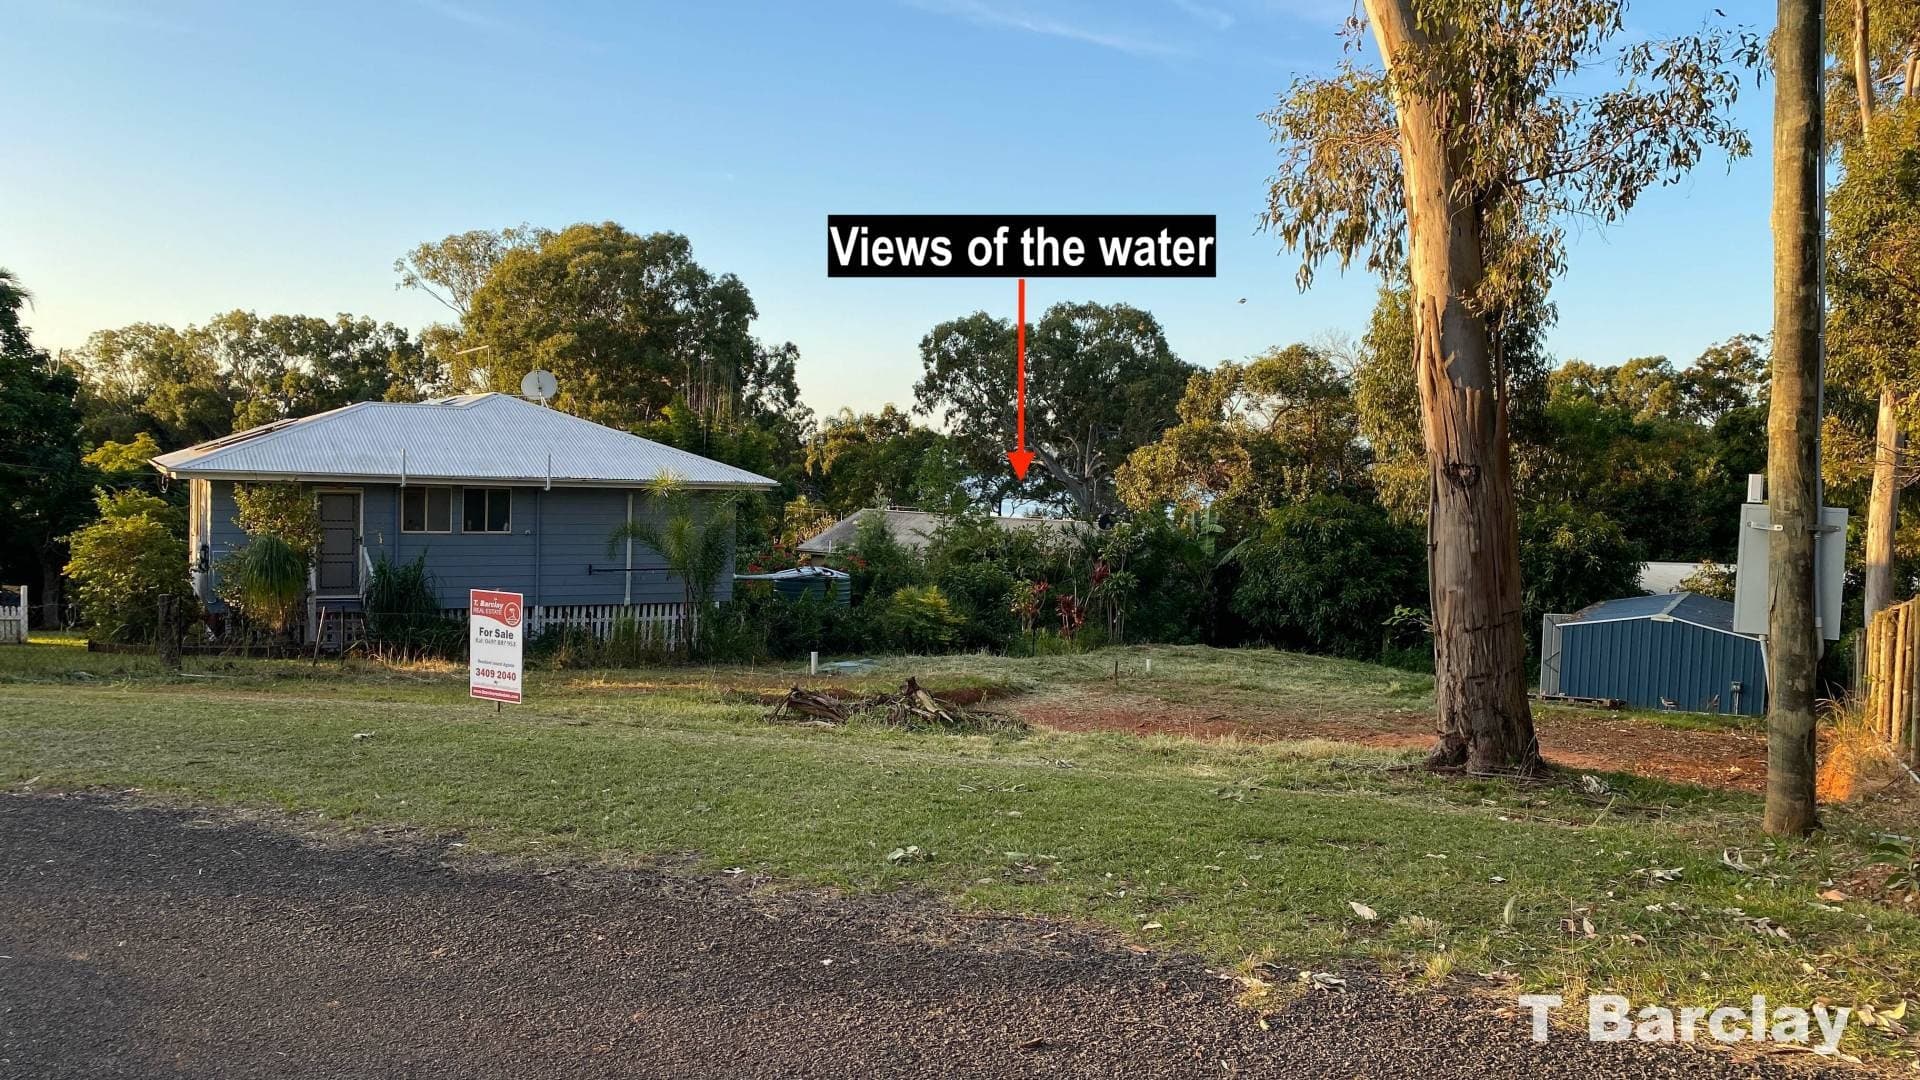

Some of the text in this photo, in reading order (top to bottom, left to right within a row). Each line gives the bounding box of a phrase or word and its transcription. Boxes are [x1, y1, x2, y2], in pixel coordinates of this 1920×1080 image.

[480, 600, 504, 609] Barclay
[479, 627, 514, 640] For Sale
[476, 668, 516, 681] 3409 2040
